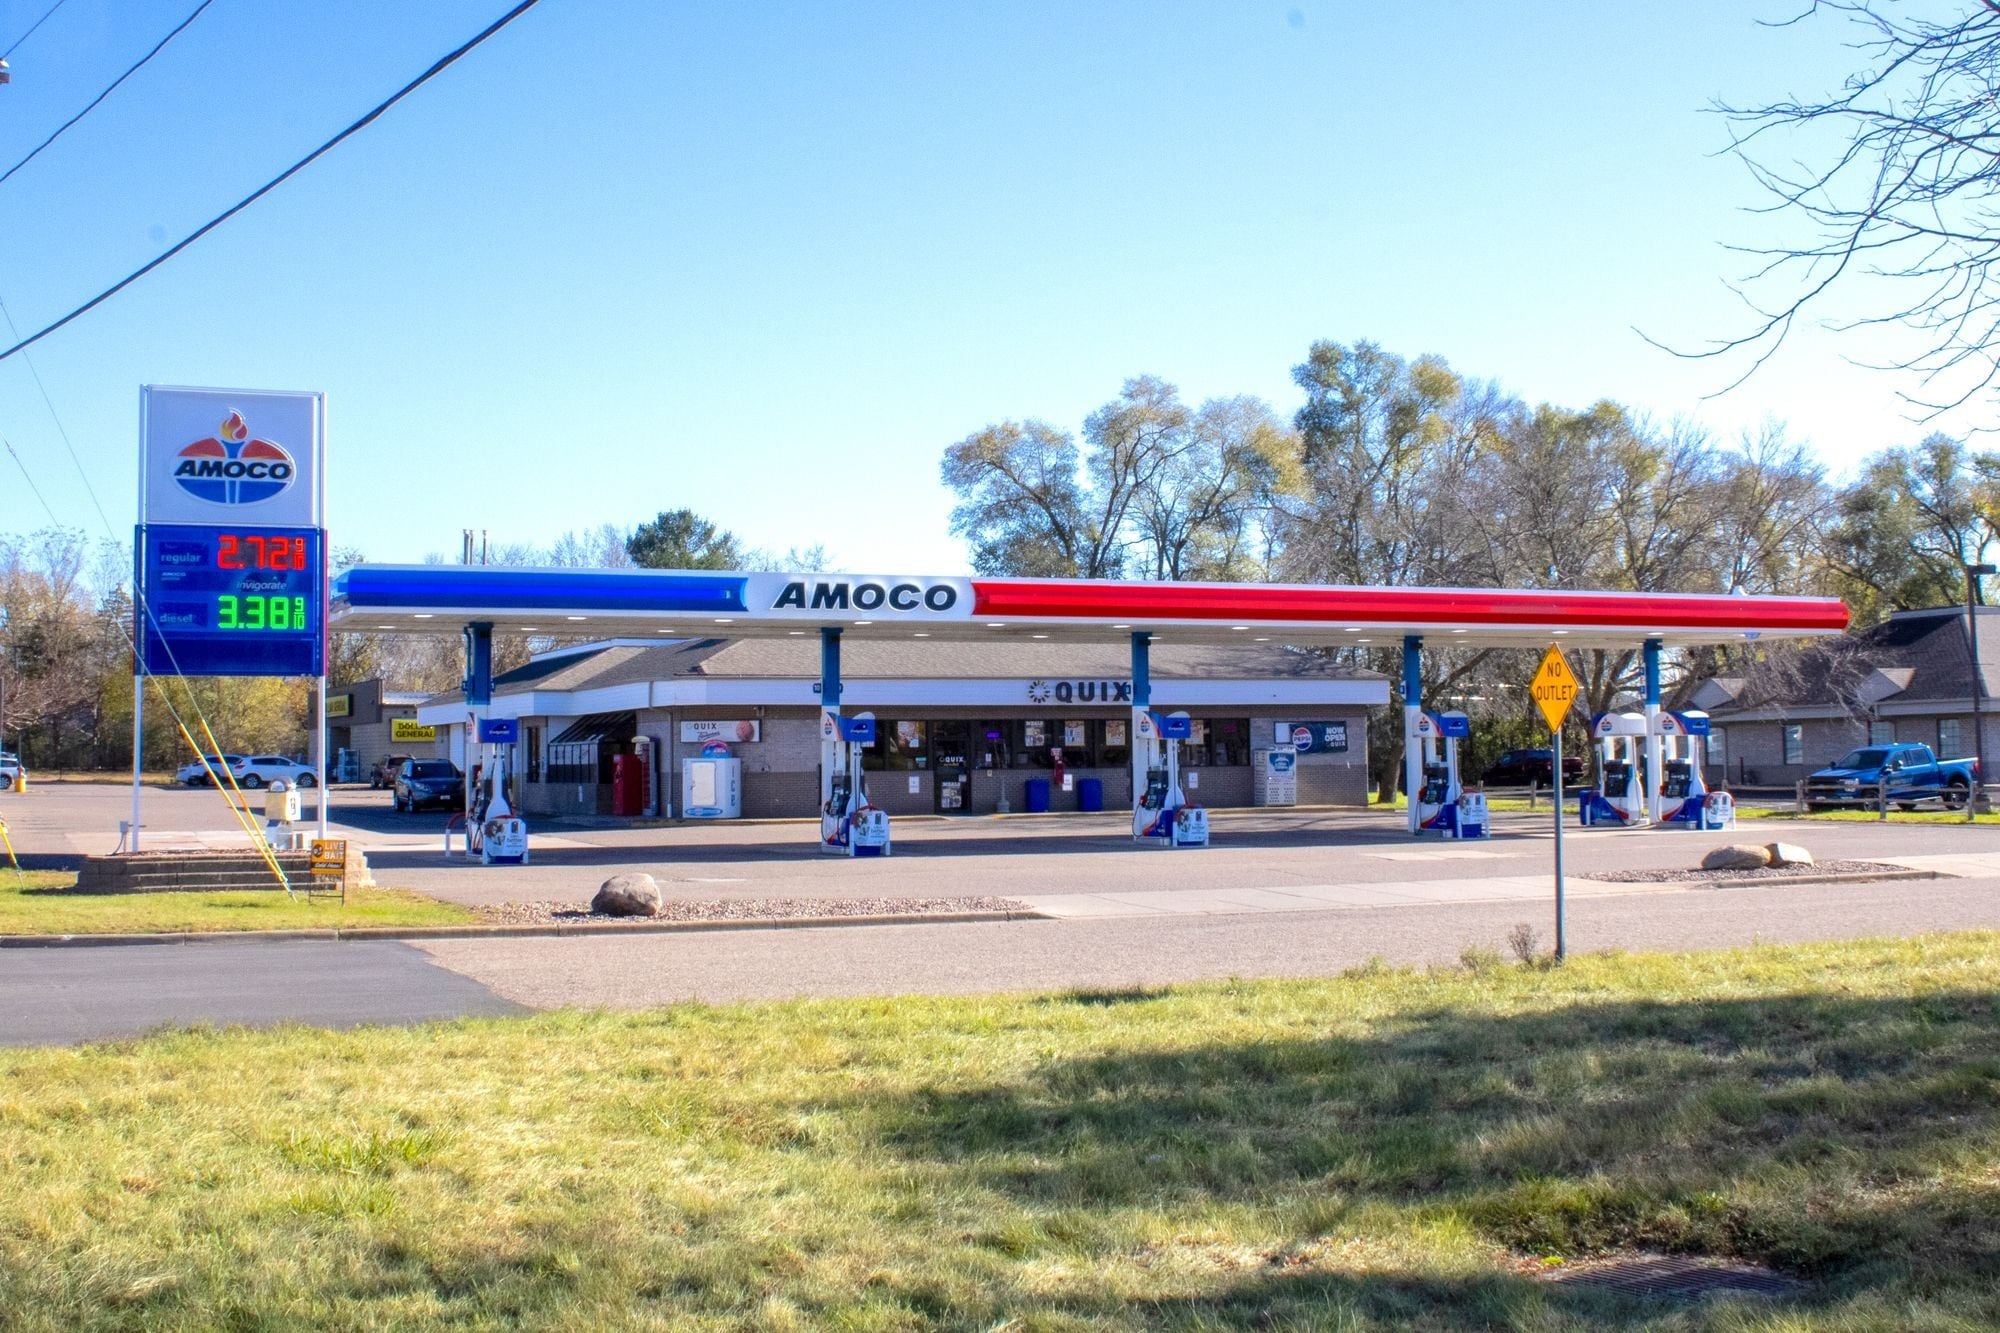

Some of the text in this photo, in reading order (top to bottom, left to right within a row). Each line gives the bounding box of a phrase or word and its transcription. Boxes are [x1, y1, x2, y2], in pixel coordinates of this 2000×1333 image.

[174, 460, 292, 480] AMOCO
[161, 553, 202, 563] regular
[218, 535, 289, 570] 2.72
[236, 580, 288, 592] invigorate
[770, 582, 958, 611] AMOCO
[160, 613, 193, 623] diesel
[218, 596, 289, 629] 3.38
[1547, 662, 1562, 677] NO
[1055, 681, 1130, 703] QUIX
[1536, 685, 1573, 700] OUTLET
[693, 722, 717, 730] QUIX
[1326, 726, 1345, 735] NOW
[396, 730, 434, 738] GENERAL
[1324, 734, 1346, 742] OPEN
[325, 842, 344, 850] LIVE
[325, 851, 344, 860] BAIT
